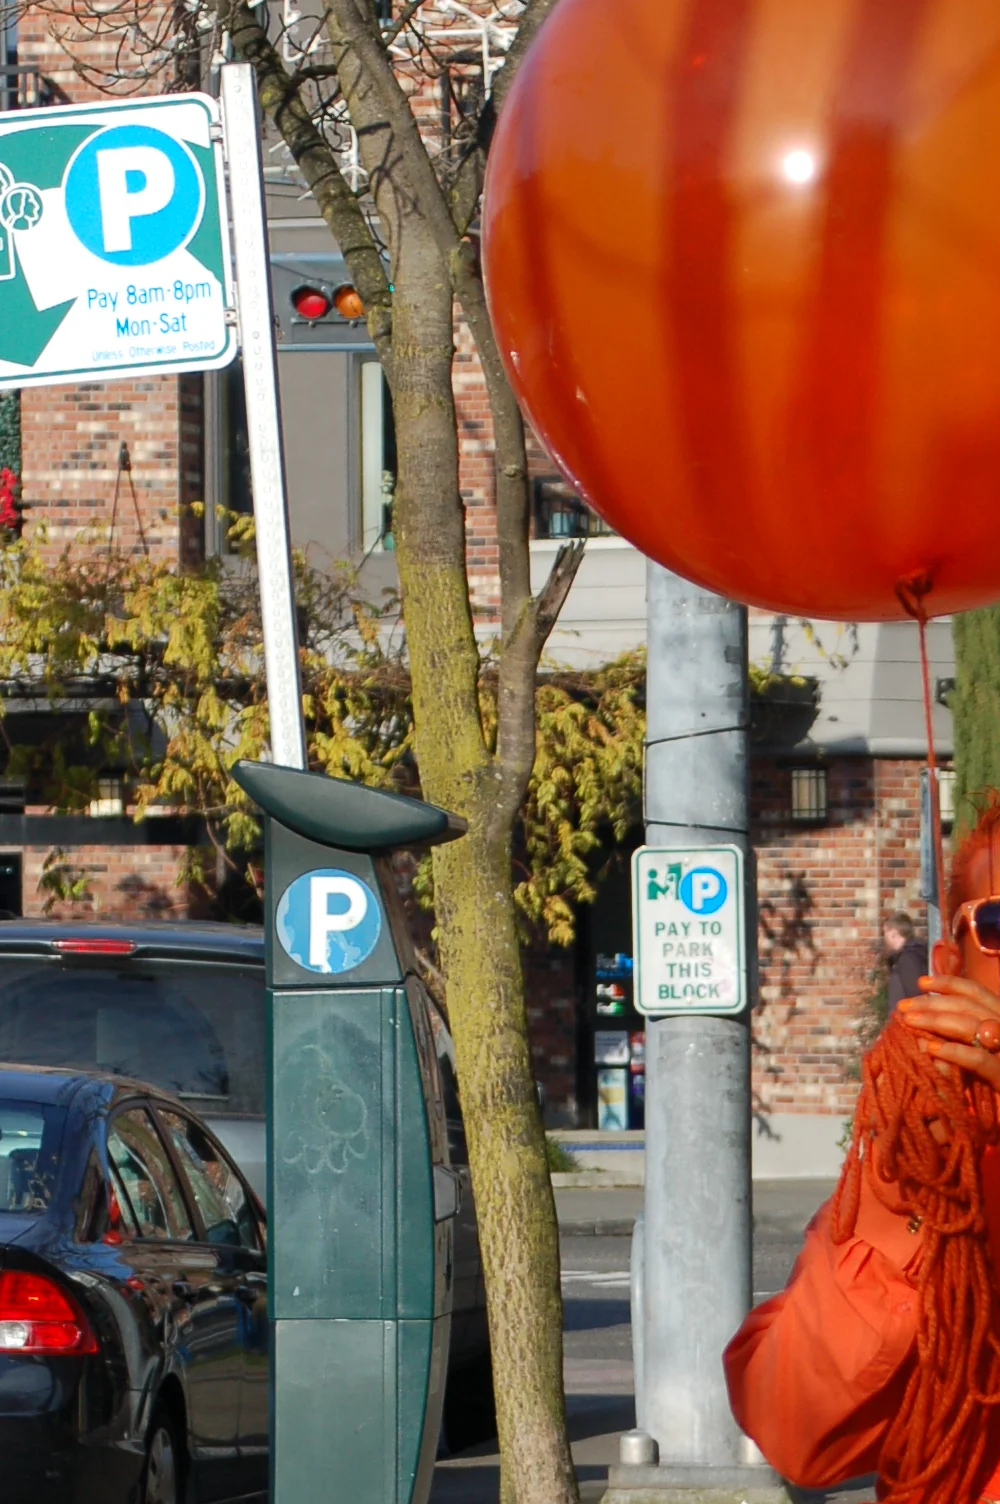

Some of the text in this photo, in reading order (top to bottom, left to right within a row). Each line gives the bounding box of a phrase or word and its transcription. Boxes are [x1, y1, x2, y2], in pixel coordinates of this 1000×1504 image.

[96, 145, 175, 253] P
[87, 288, 119, 313] Pay
[92, 350, 123, 362] Unless
[183, 340, 215, 352] Posted
[691, 873, 720, 910] P
[310, 876, 368, 965] P
[655, 921, 722, 937] PAY TO
[662, 942, 714, 957] PARK
[666, 963, 712, 978] THIS
[658, 984, 720, 1000] BLOCK
